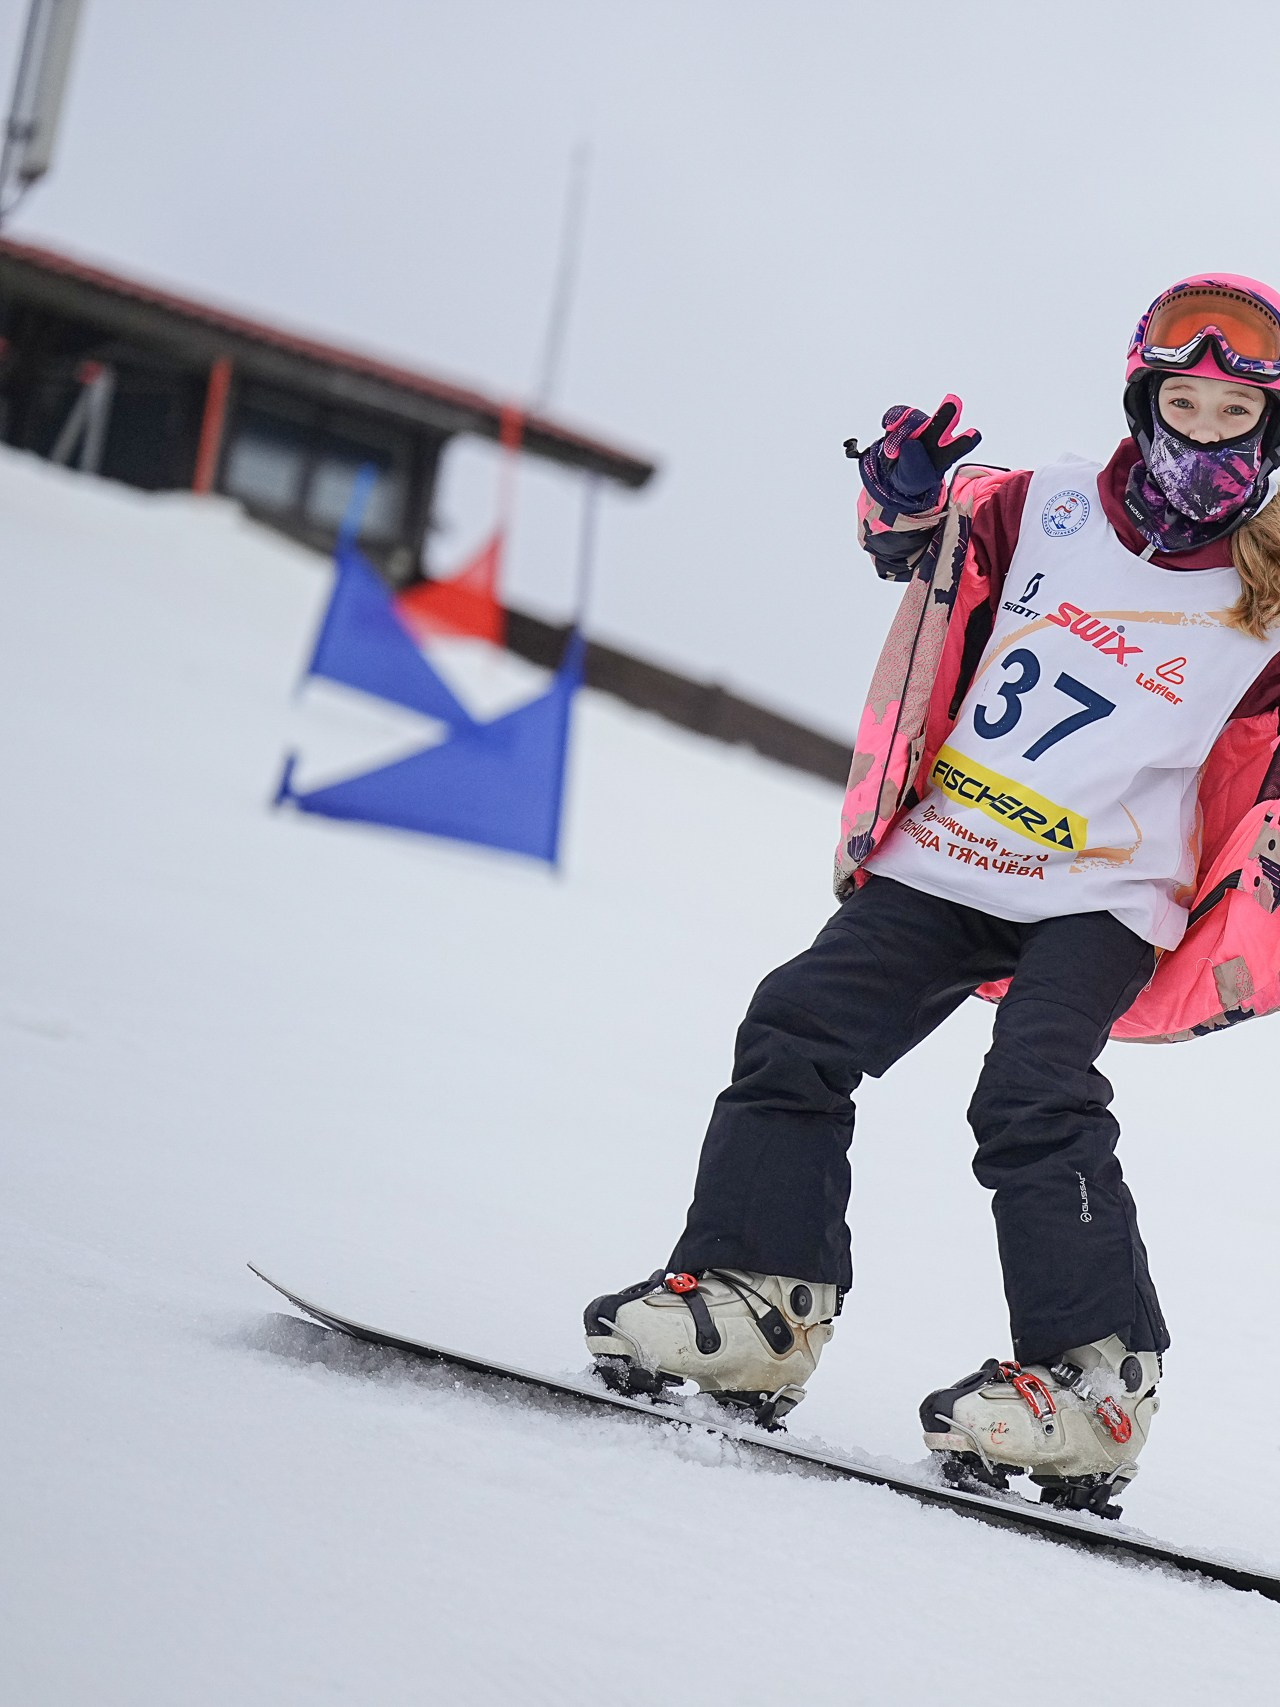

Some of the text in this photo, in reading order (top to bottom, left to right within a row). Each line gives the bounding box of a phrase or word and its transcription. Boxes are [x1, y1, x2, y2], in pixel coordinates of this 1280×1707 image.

[973, 648, 1117, 762] 37
[1135, 672, 1183, 706] Löffler
[932, 759, 1048, 834] FISCHER
[947, 842, 1044, 880] ТЯГАЧЁВА
